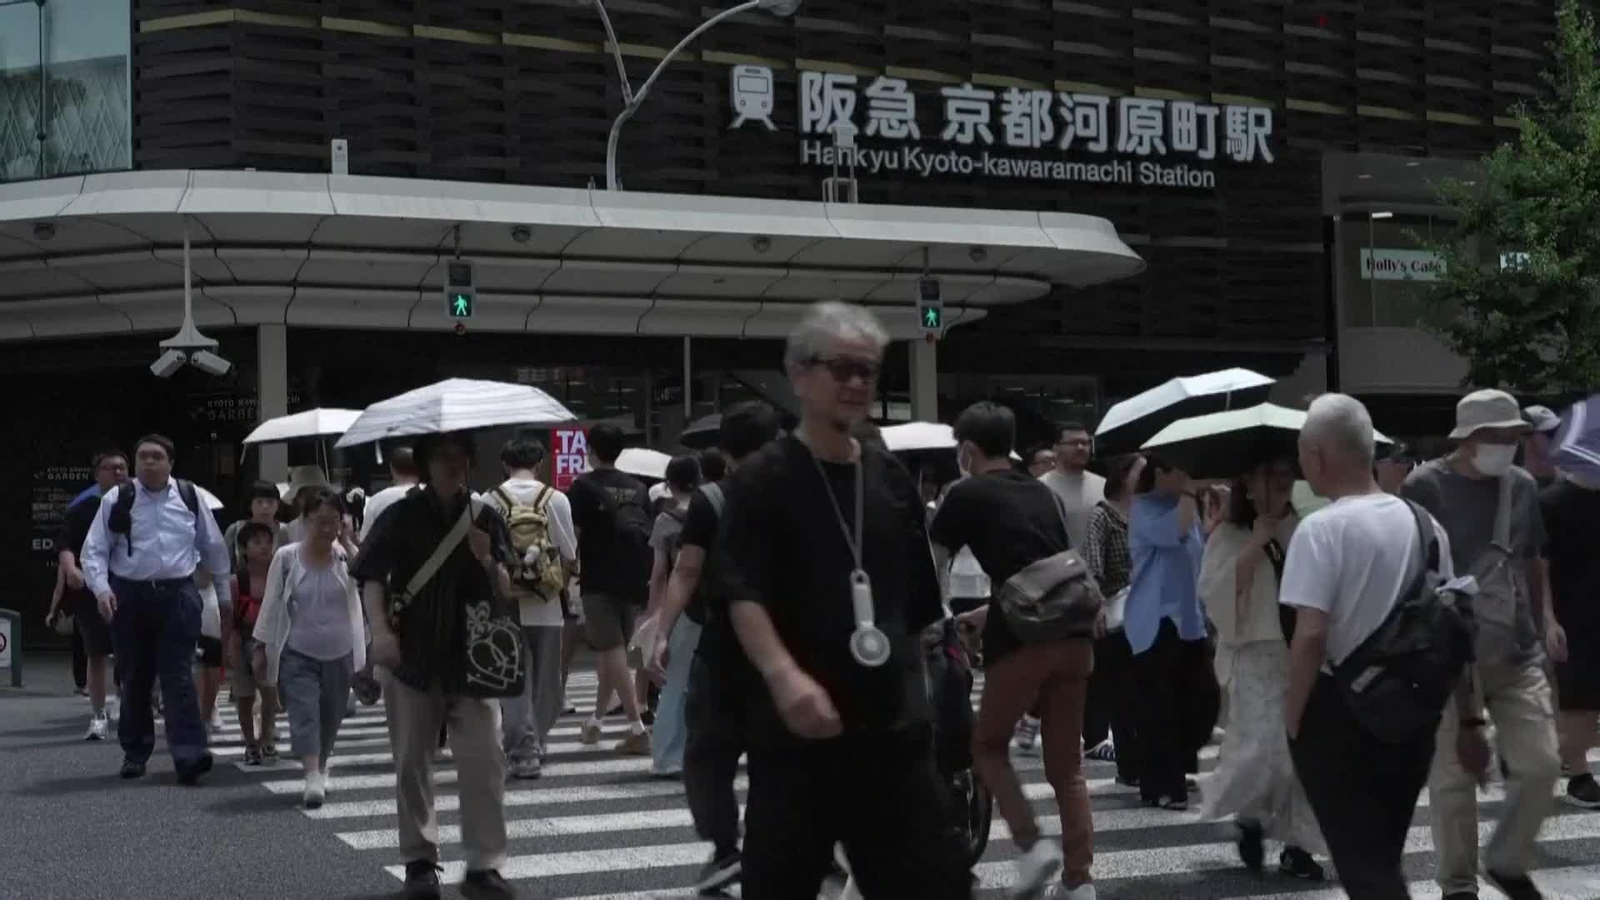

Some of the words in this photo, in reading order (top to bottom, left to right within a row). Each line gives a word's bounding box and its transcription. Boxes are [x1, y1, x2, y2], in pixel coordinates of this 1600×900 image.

[801, 71, 921, 140] 阪急
[942, 83, 1274, 164] 京都河原町駅
[802, 140, 898, 174] Hankyu
[903, 146, 1132, 184] Kyoto-kawaramachi
[1139, 162, 1215, 187] Station
[1366, 257, 1407, 273] Holly's
[208, 408, 259, 421] GARDE
[47, 472, 89, 481] GARDEN
